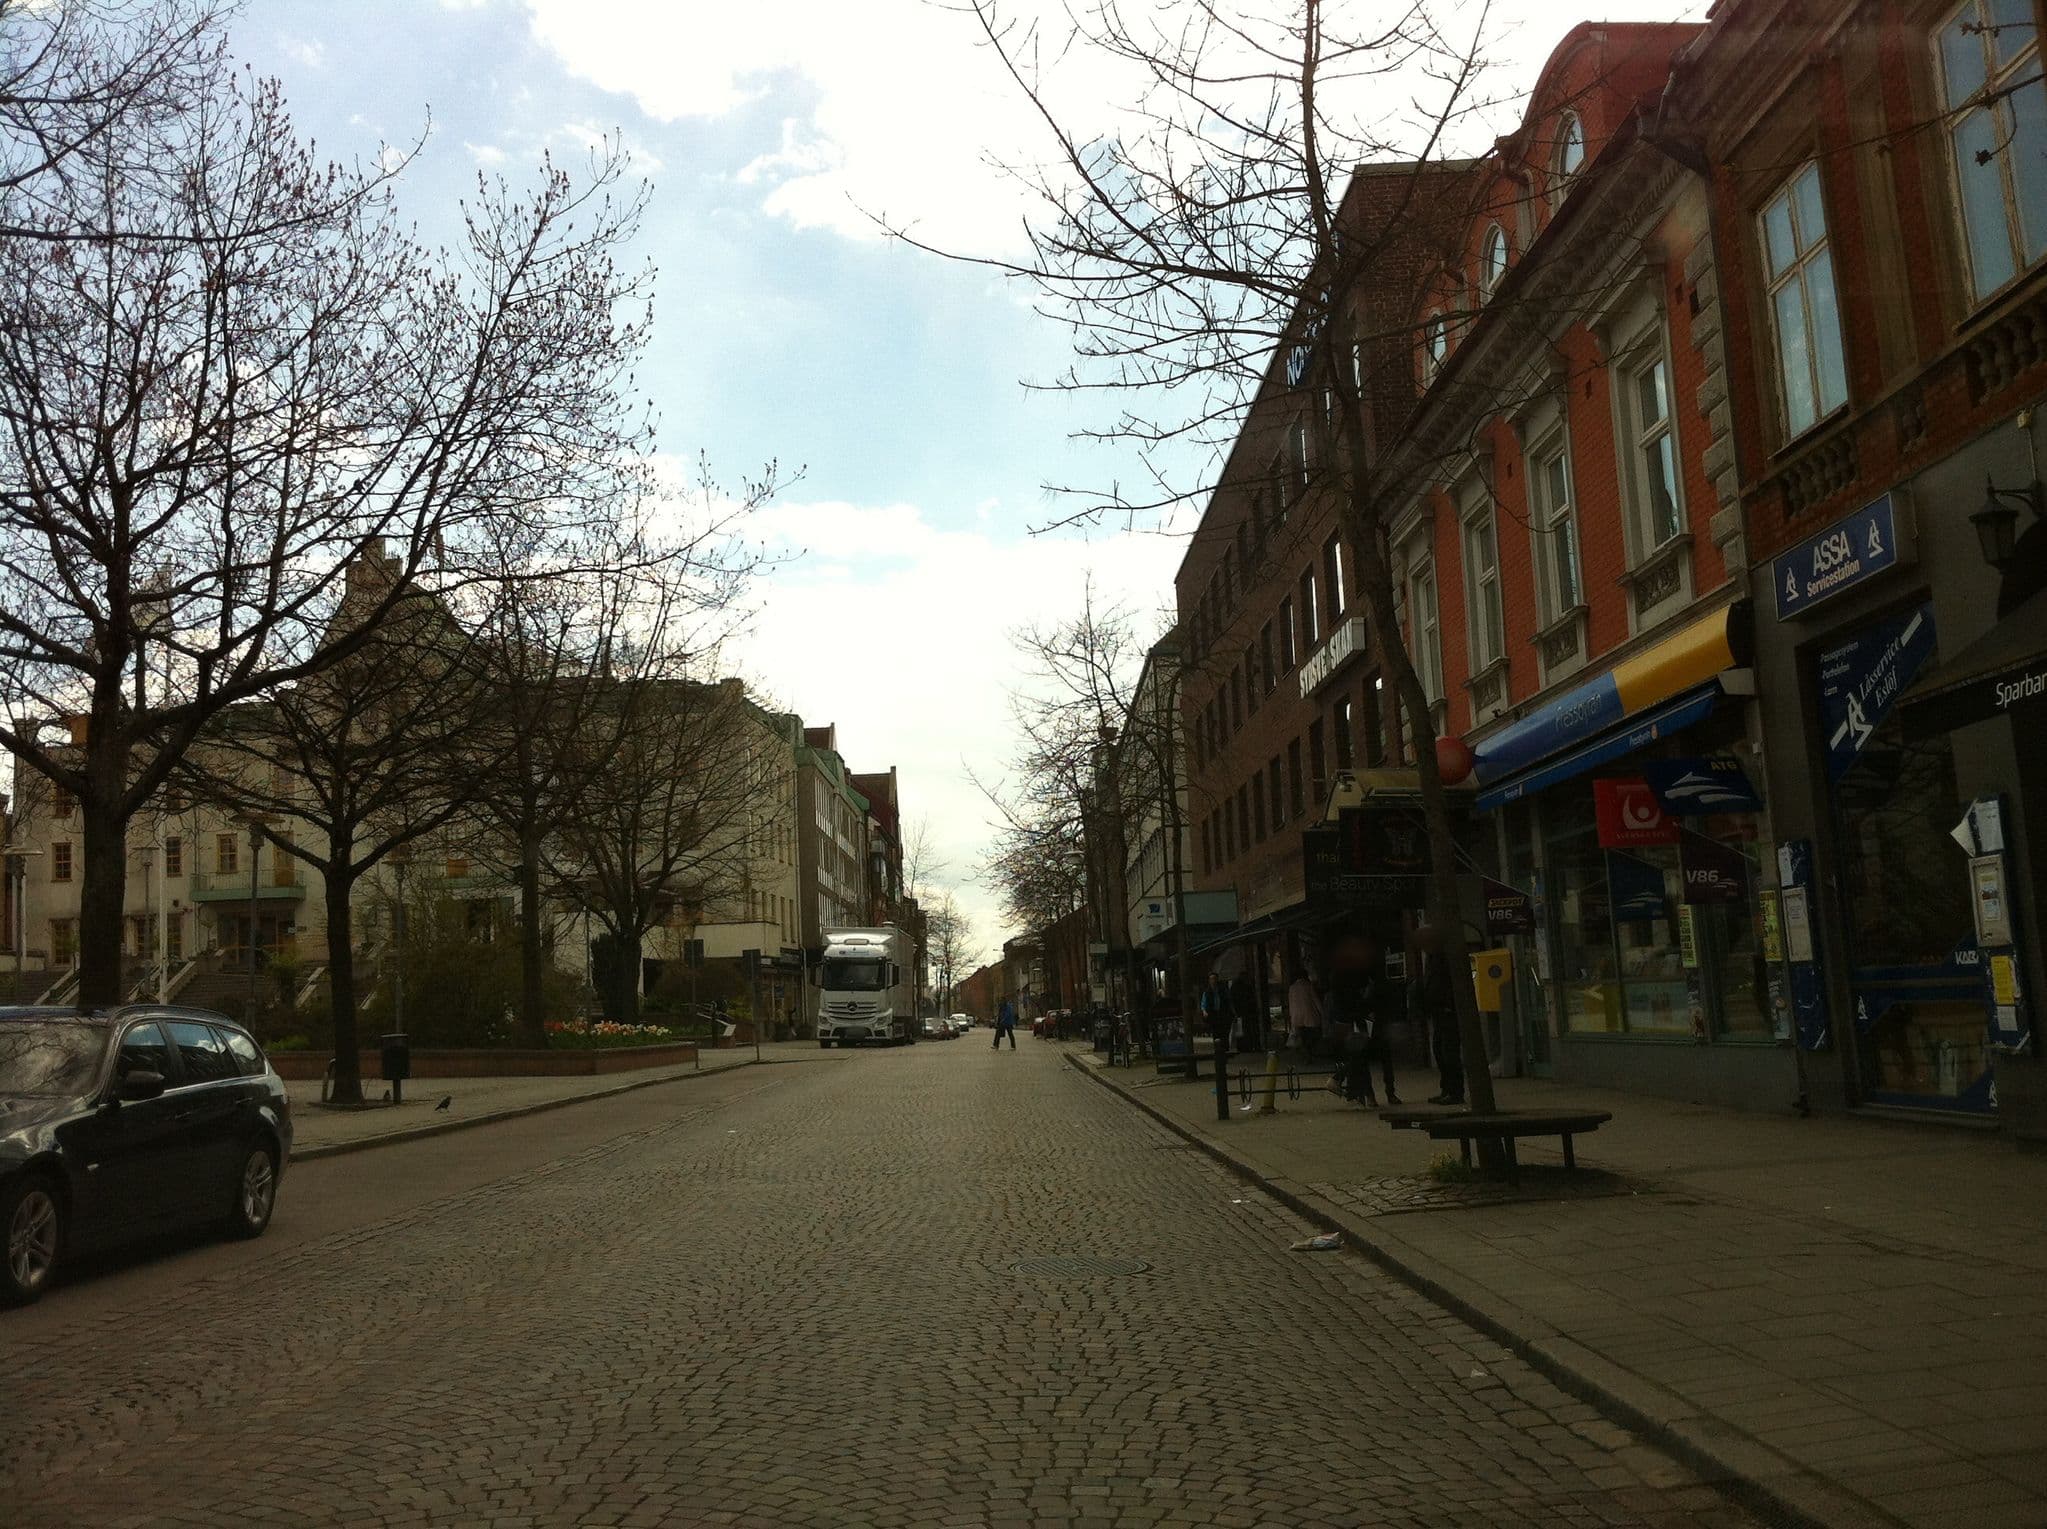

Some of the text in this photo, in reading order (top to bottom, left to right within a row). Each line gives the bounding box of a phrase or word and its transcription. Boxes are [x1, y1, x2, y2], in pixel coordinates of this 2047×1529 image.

[1813, 530, 1851, 577] ASSA
[1806, 558, 1861, 598] Servicestation
[1685, 866, 1720, 885] V86
[1486, 908, 1513, 921] V86
